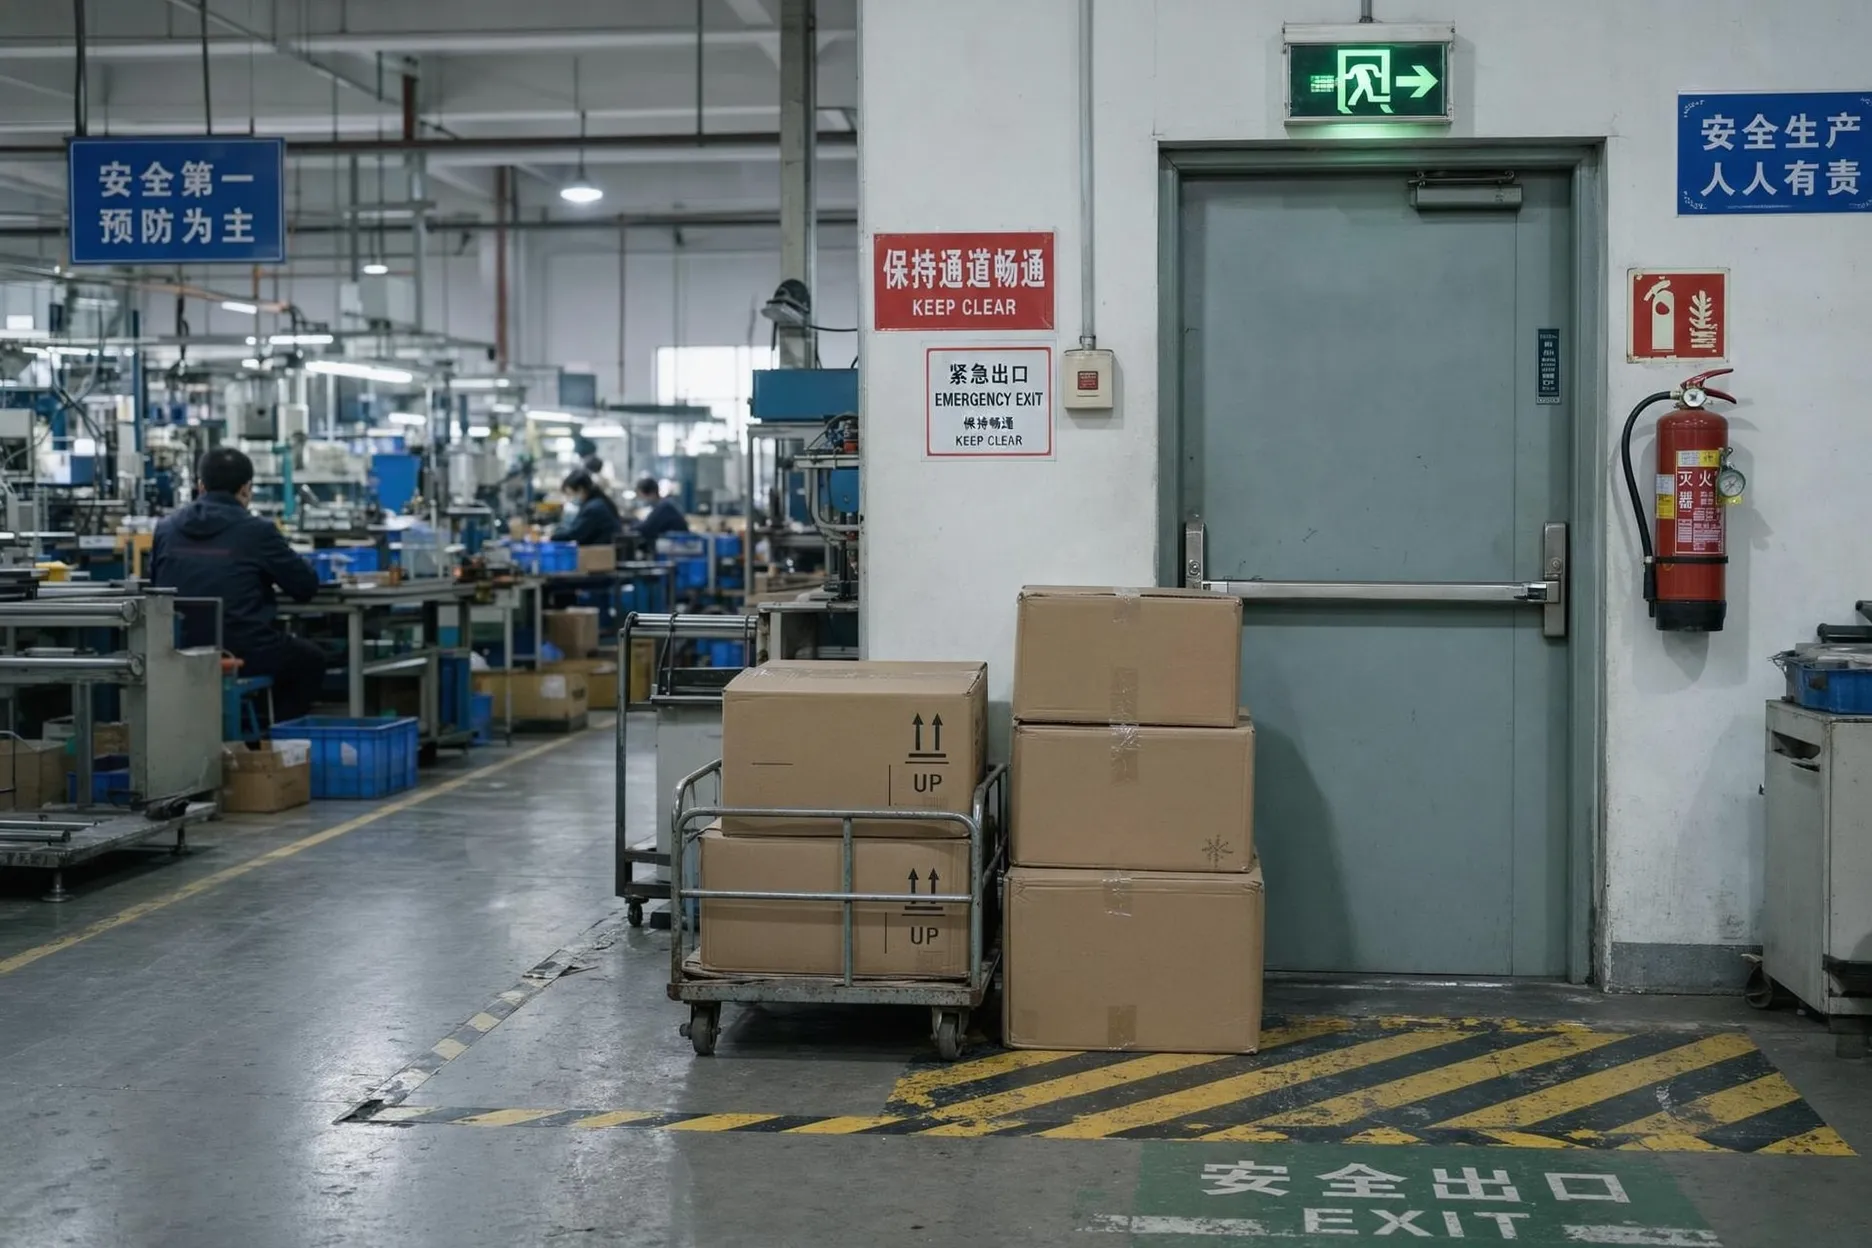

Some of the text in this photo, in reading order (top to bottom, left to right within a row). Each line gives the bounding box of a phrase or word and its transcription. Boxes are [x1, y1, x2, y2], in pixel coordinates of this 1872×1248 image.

[1701, 112, 1861, 151] 安全生产
[99, 160, 254, 198] 安全第一
[1700, 159, 1861, 196] 人人有责
[99, 207, 255, 244] 预防为主
[883, 248, 1045, 290] 保持通道畅通
[912, 299, 1016, 316] KEEP CLEAR
[950, 363, 1028, 385] 紧急出口
[935, 392, 1043, 406] EMERGENCY EXIT
[956, 435, 1023, 446] KEEP CLEAR
[913, 774, 943, 793] UP
[910, 927, 939, 945] UP
[1200, 1160, 1631, 1203] 安全出口
[1303, 1208, 1531, 1240] EXIT
